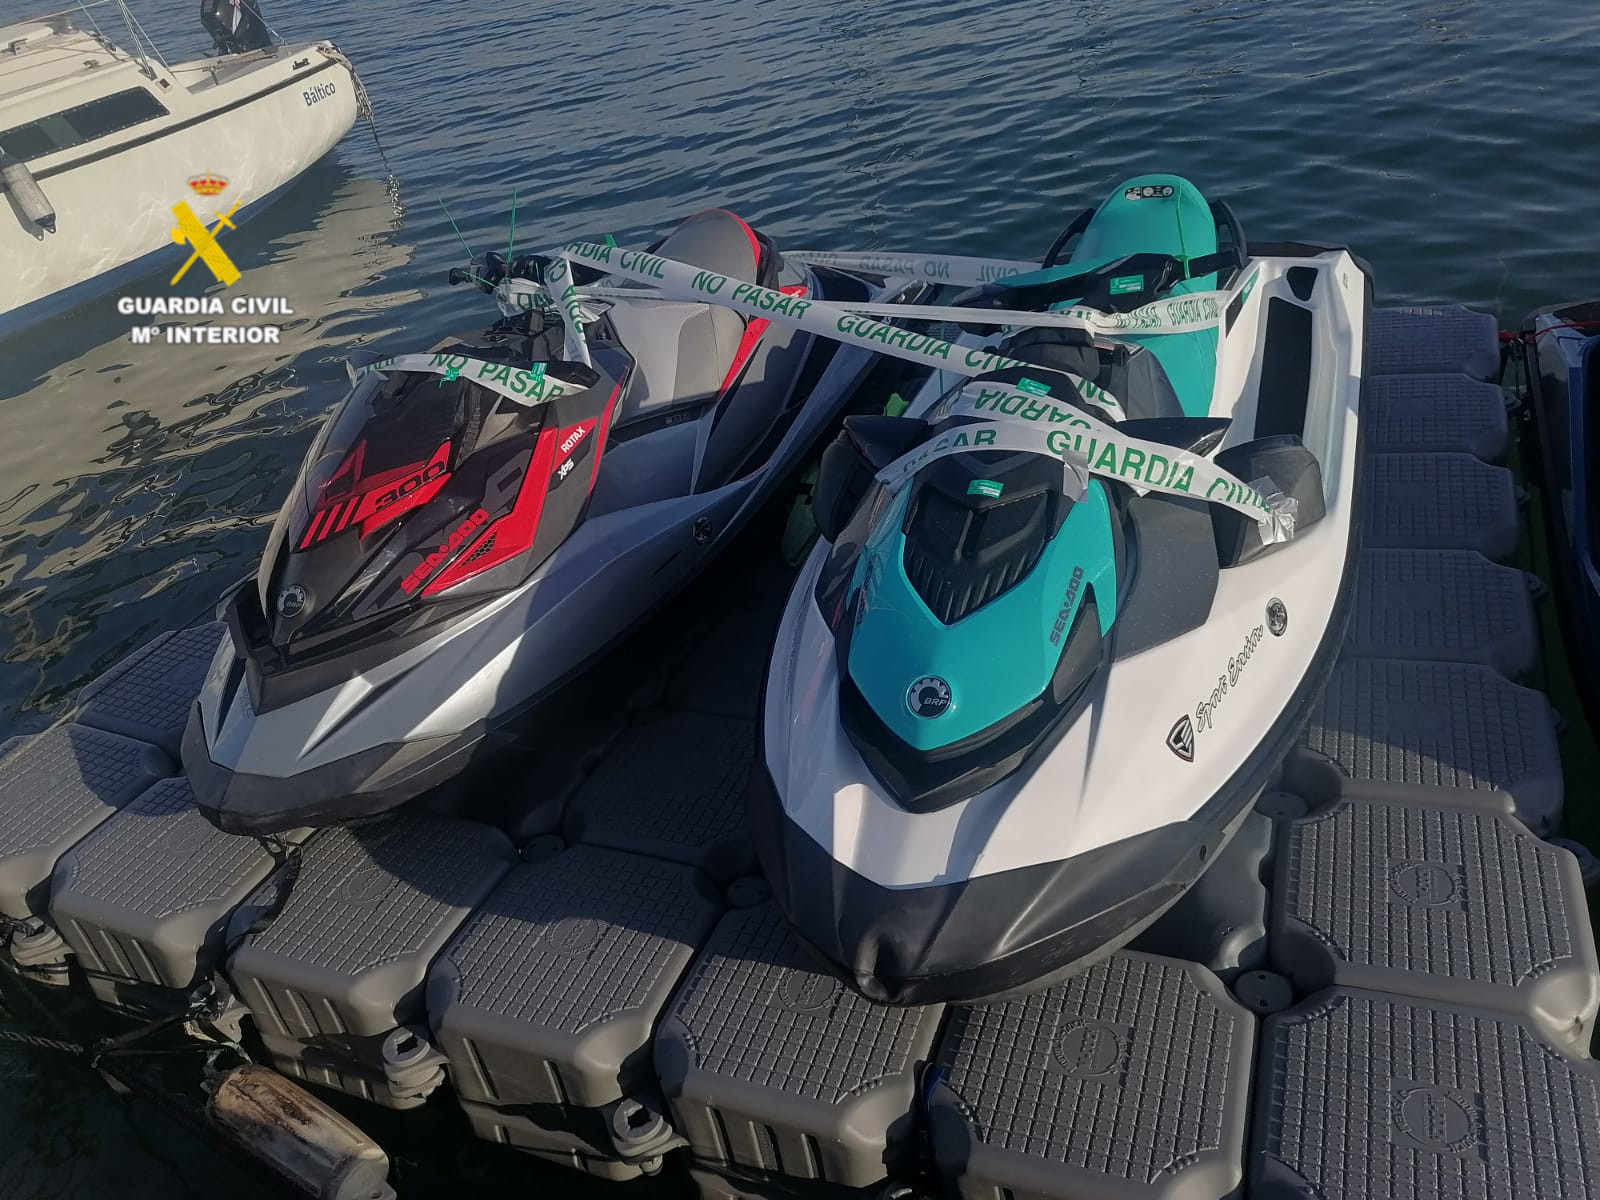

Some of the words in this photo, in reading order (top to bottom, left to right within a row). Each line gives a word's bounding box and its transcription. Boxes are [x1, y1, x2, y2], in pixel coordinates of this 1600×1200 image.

[303, 82, 336, 106] Báltico
[620, 251, 667, 280] CIVIL
[691, 271, 727, 294] NO
[732, 281, 813, 320] PASAR
[836, 314, 951, 360] GUARDIA
[560, 425, 586, 453] ROTAX
[557, 457, 575, 481] XPS
[1046, 430, 1195, 492] GUARDIA
[375, 461, 446, 512] 300
[923, 697, 949, 706] BRP
